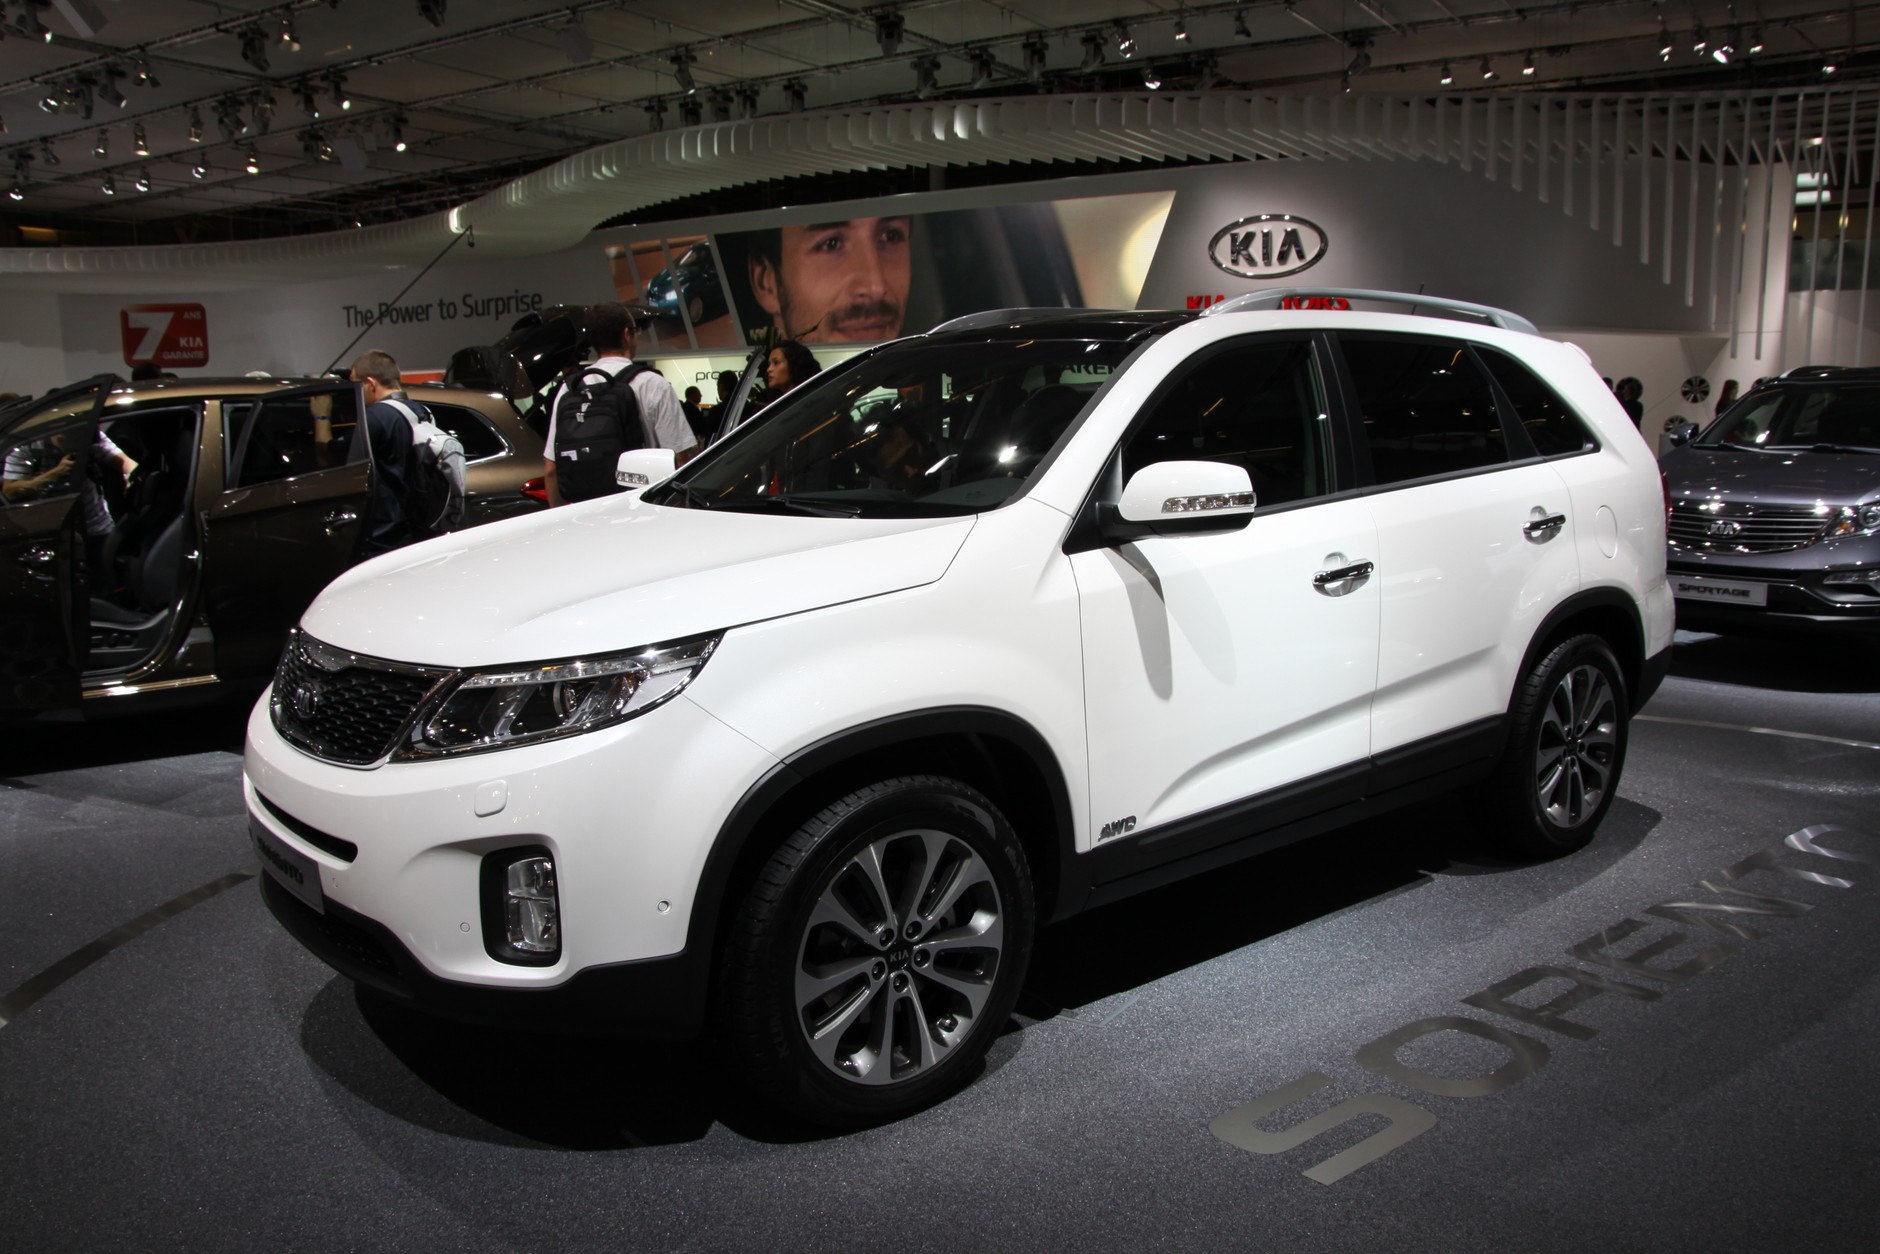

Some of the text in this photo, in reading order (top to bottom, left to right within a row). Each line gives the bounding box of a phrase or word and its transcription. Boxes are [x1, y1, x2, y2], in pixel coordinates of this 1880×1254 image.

[1230, 228, 1306, 267] KIA
[342, 289, 543, 328] The Power to Surprise
[1281, 296, 1350, 311] TORS
[183, 311, 201, 320] ANS
[127, 311, 176, 360] 7
[179, 337, 204, 348] KIA
[1710, 523, 1734, 535] KIA
[1678, 583, 1751, 598] SPORTAGE
[1097, 815, 1137, 842] AWD
[890, 949, 909, 962] KIA
[1208, 823, 1868, 1186] SORENTO
